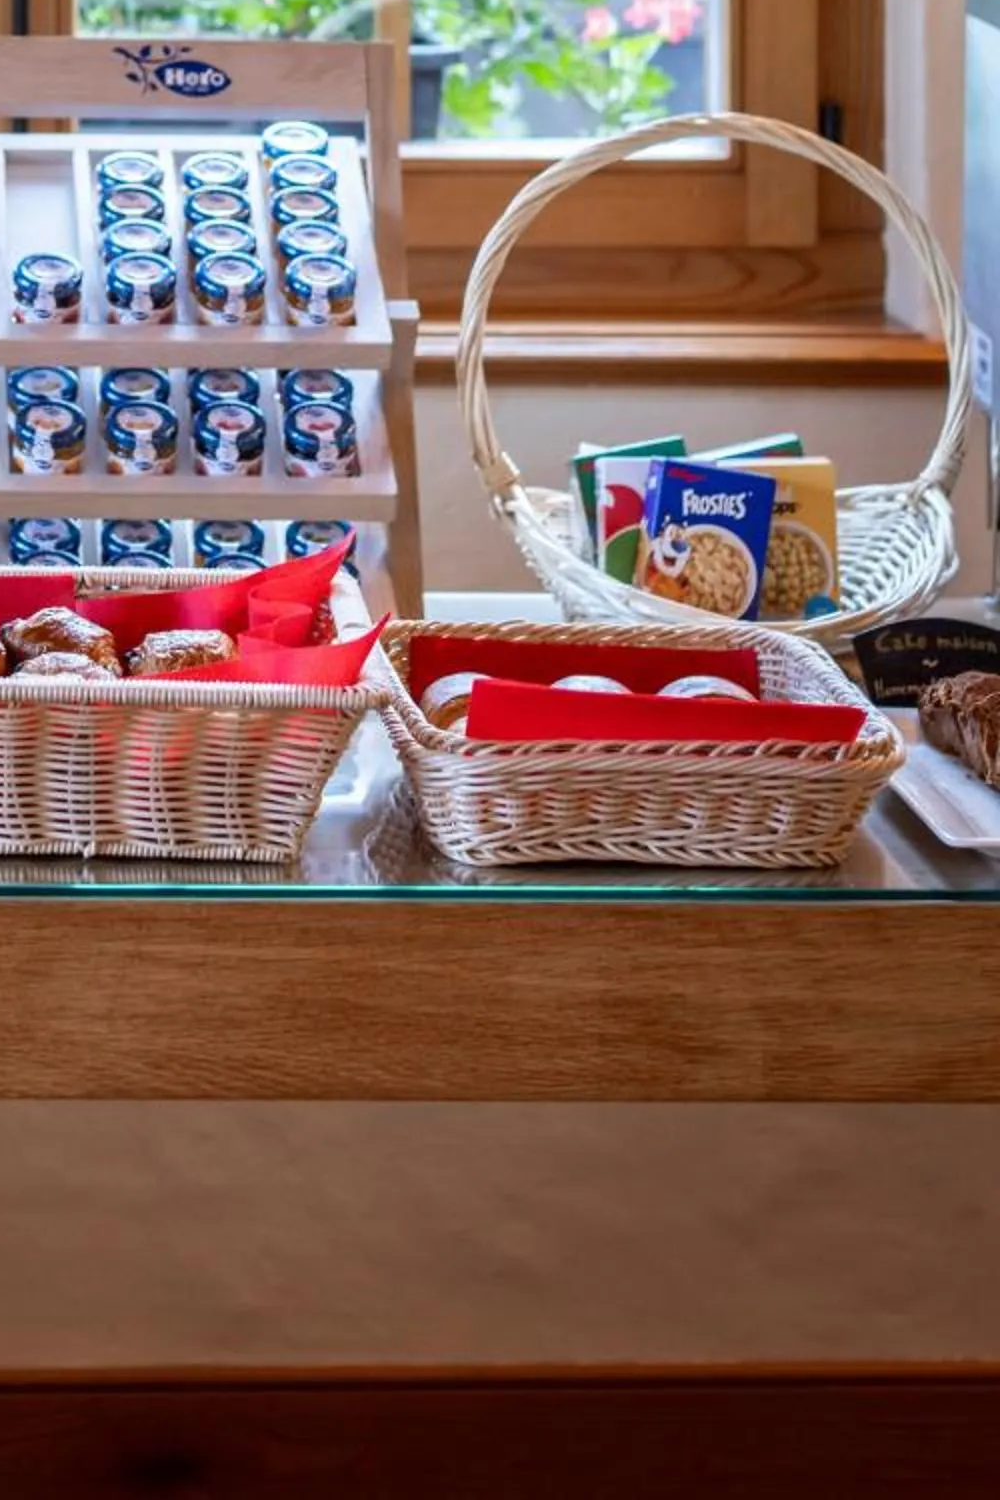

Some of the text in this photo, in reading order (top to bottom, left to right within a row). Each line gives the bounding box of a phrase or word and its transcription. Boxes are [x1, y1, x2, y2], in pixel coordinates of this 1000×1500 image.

[164, 67, 225, 87] Hero
[681, 488, 747, 520] FROSTIES
[874, 629, 927, 653] Cake
